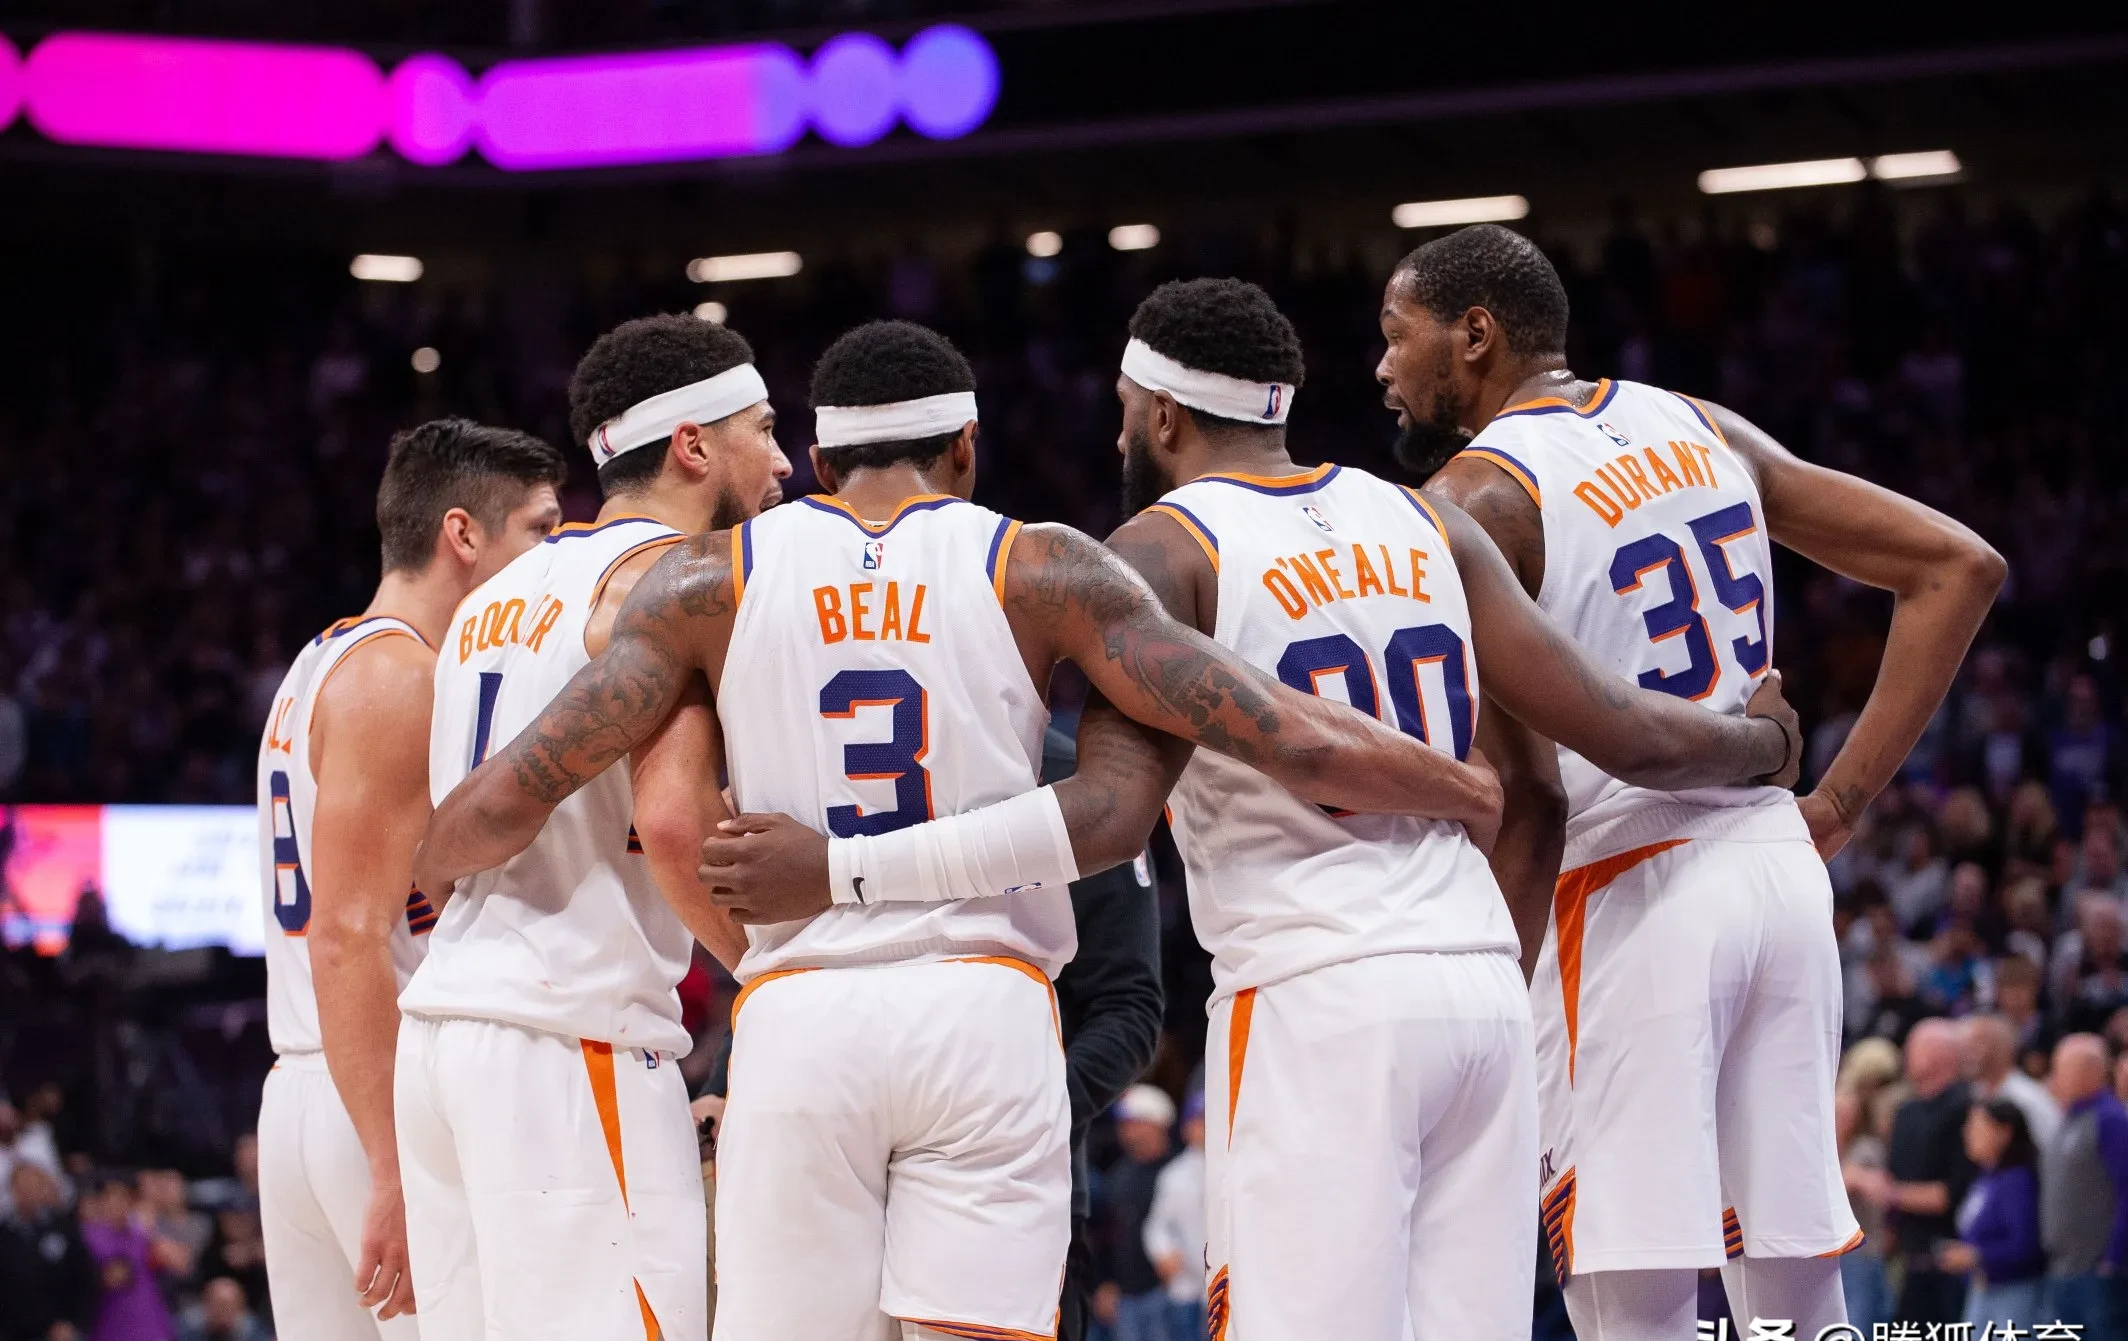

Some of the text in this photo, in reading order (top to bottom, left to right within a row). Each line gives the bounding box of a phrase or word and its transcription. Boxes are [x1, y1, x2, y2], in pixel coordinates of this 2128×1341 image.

[1573, 440, 1718, 529] DURANT
[813, 582, 931, 644] BEAL
[1263, 543, 1431, 621] O'NEALE
[1608, 502, 1768, 702] 35
[460, 594, 563, 664] BOOR
[820, 670, 934, 838] 3
[271, 771, 312, 937] 8
